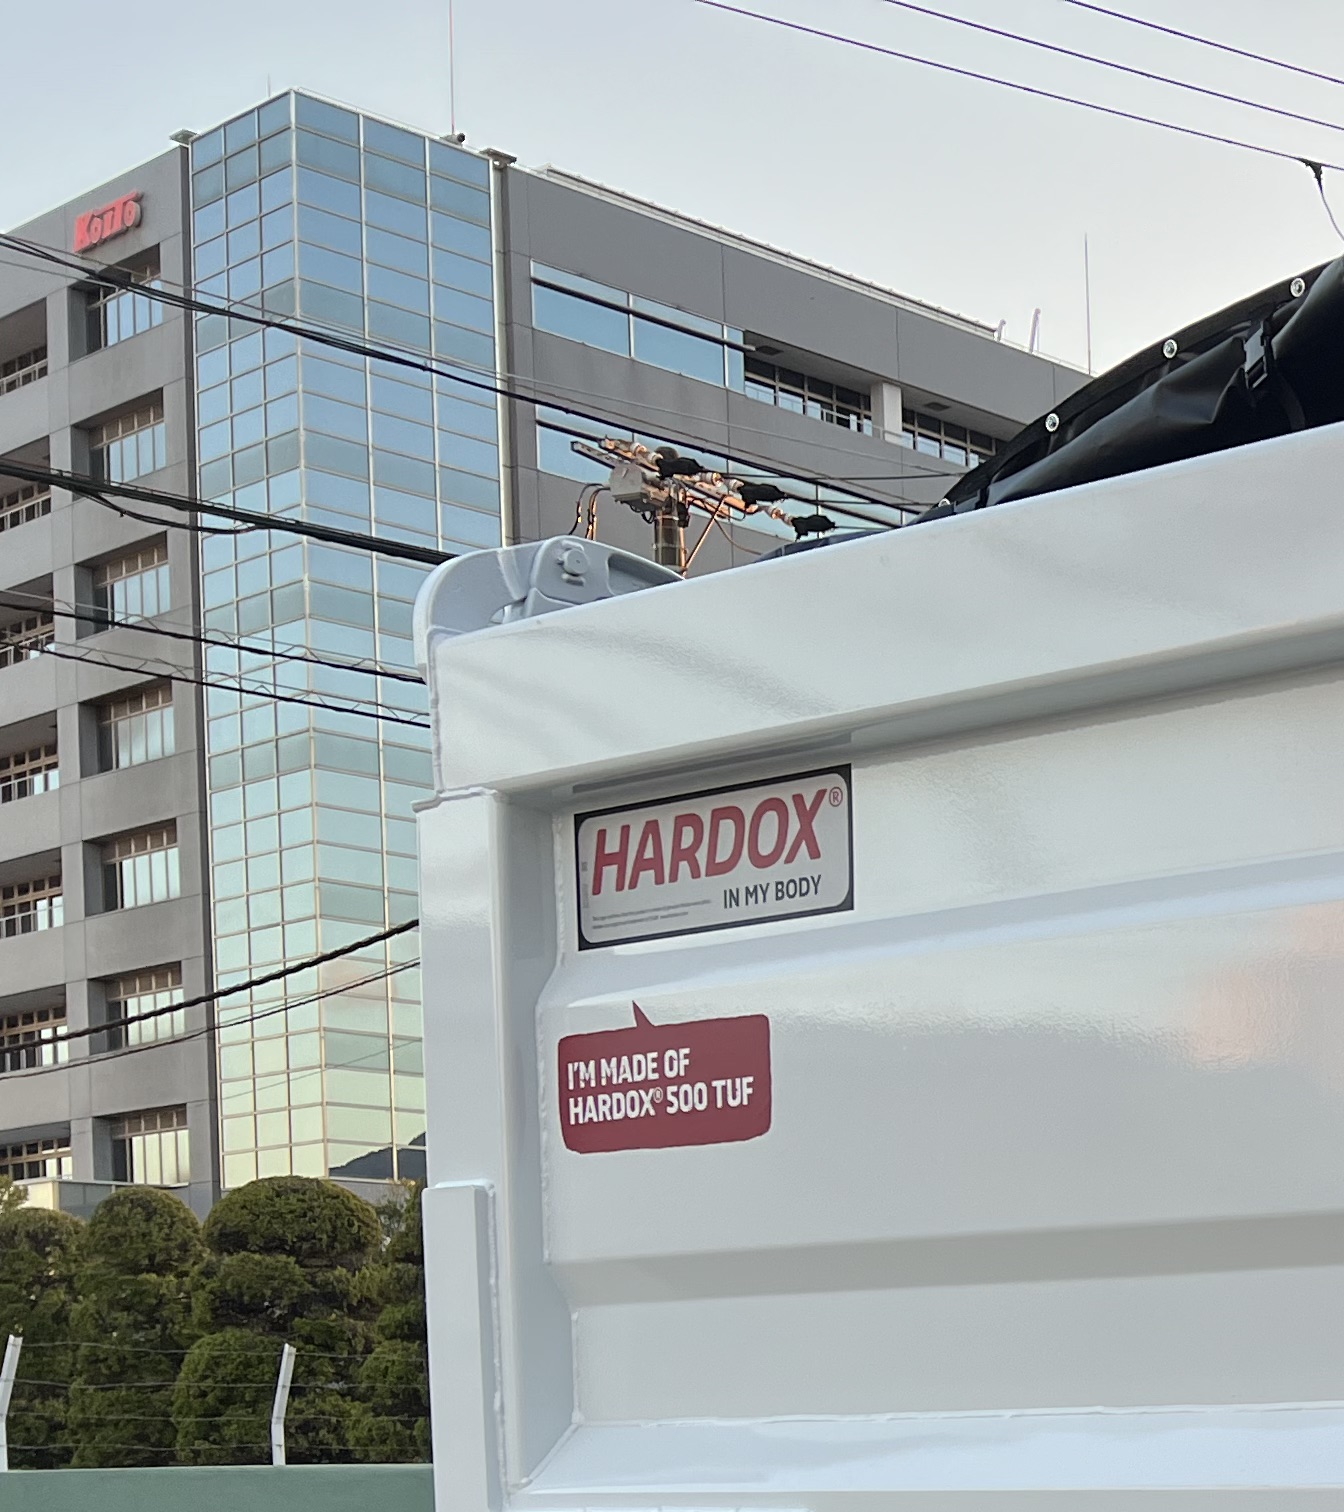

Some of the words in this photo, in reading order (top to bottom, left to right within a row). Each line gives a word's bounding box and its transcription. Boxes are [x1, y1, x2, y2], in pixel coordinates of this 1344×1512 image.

[723, 886, 741, 909] IN
[744, 882, 771, 906] MY
[774, 874, 822, 901] BODY
[600, 1051, 660, 1085] MADE
[664, 1047, 692, 1076] OF
[666, 1082, 708, 1114] 500
[712, 1076, 754, 1108] TUF
